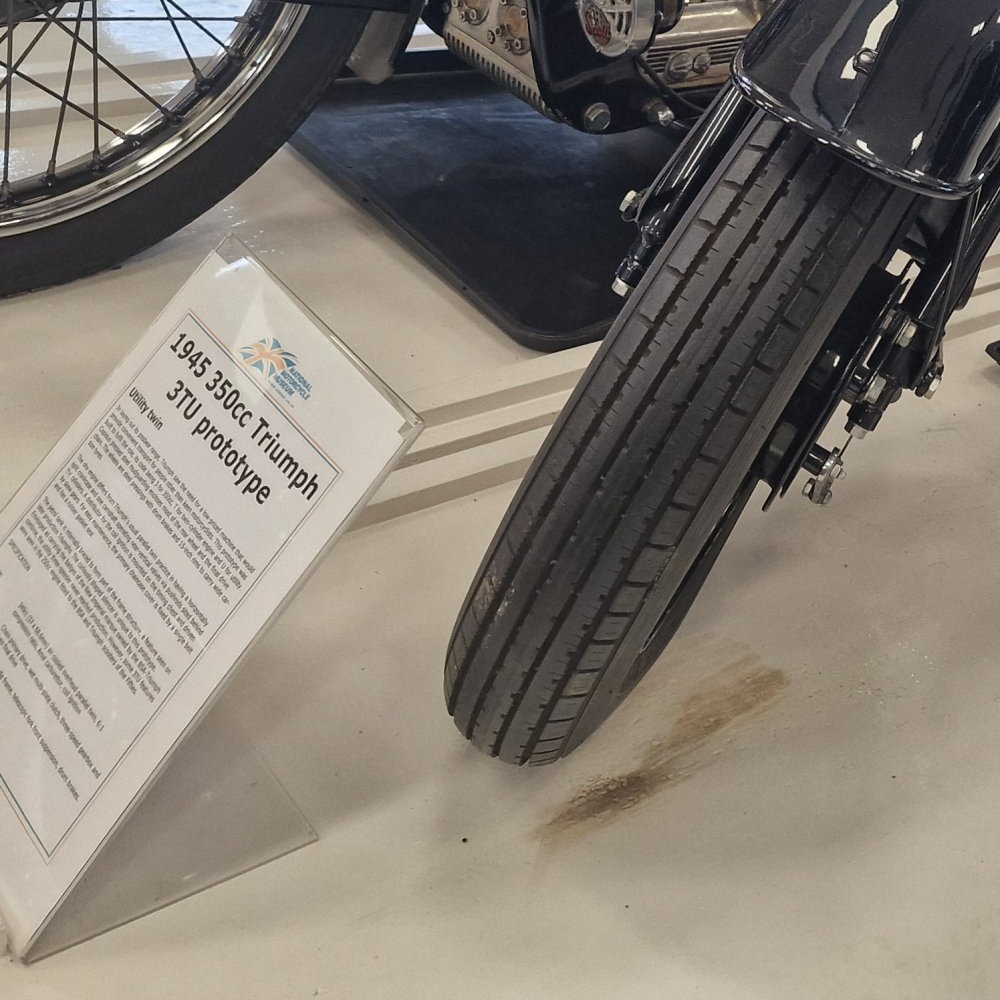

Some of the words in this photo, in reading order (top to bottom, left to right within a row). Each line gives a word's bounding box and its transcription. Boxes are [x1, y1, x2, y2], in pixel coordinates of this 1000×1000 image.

[273, 373, 295, 397] MUSEUM
[280, 370, 311, 401] MOTORCYCLE
[289, 367, 313, 392] NATIONAL
[129, 387, 150, 414] Utility
[147, 409, 163, 430] twin
[170, 333, 212, 378] 1945
[205, 370, 253, 428] 350cc
[251, 416, 319, 501] Triumph
[166, 379, 203, 420] 3TU
[191, 416, 271, 505] prototype
